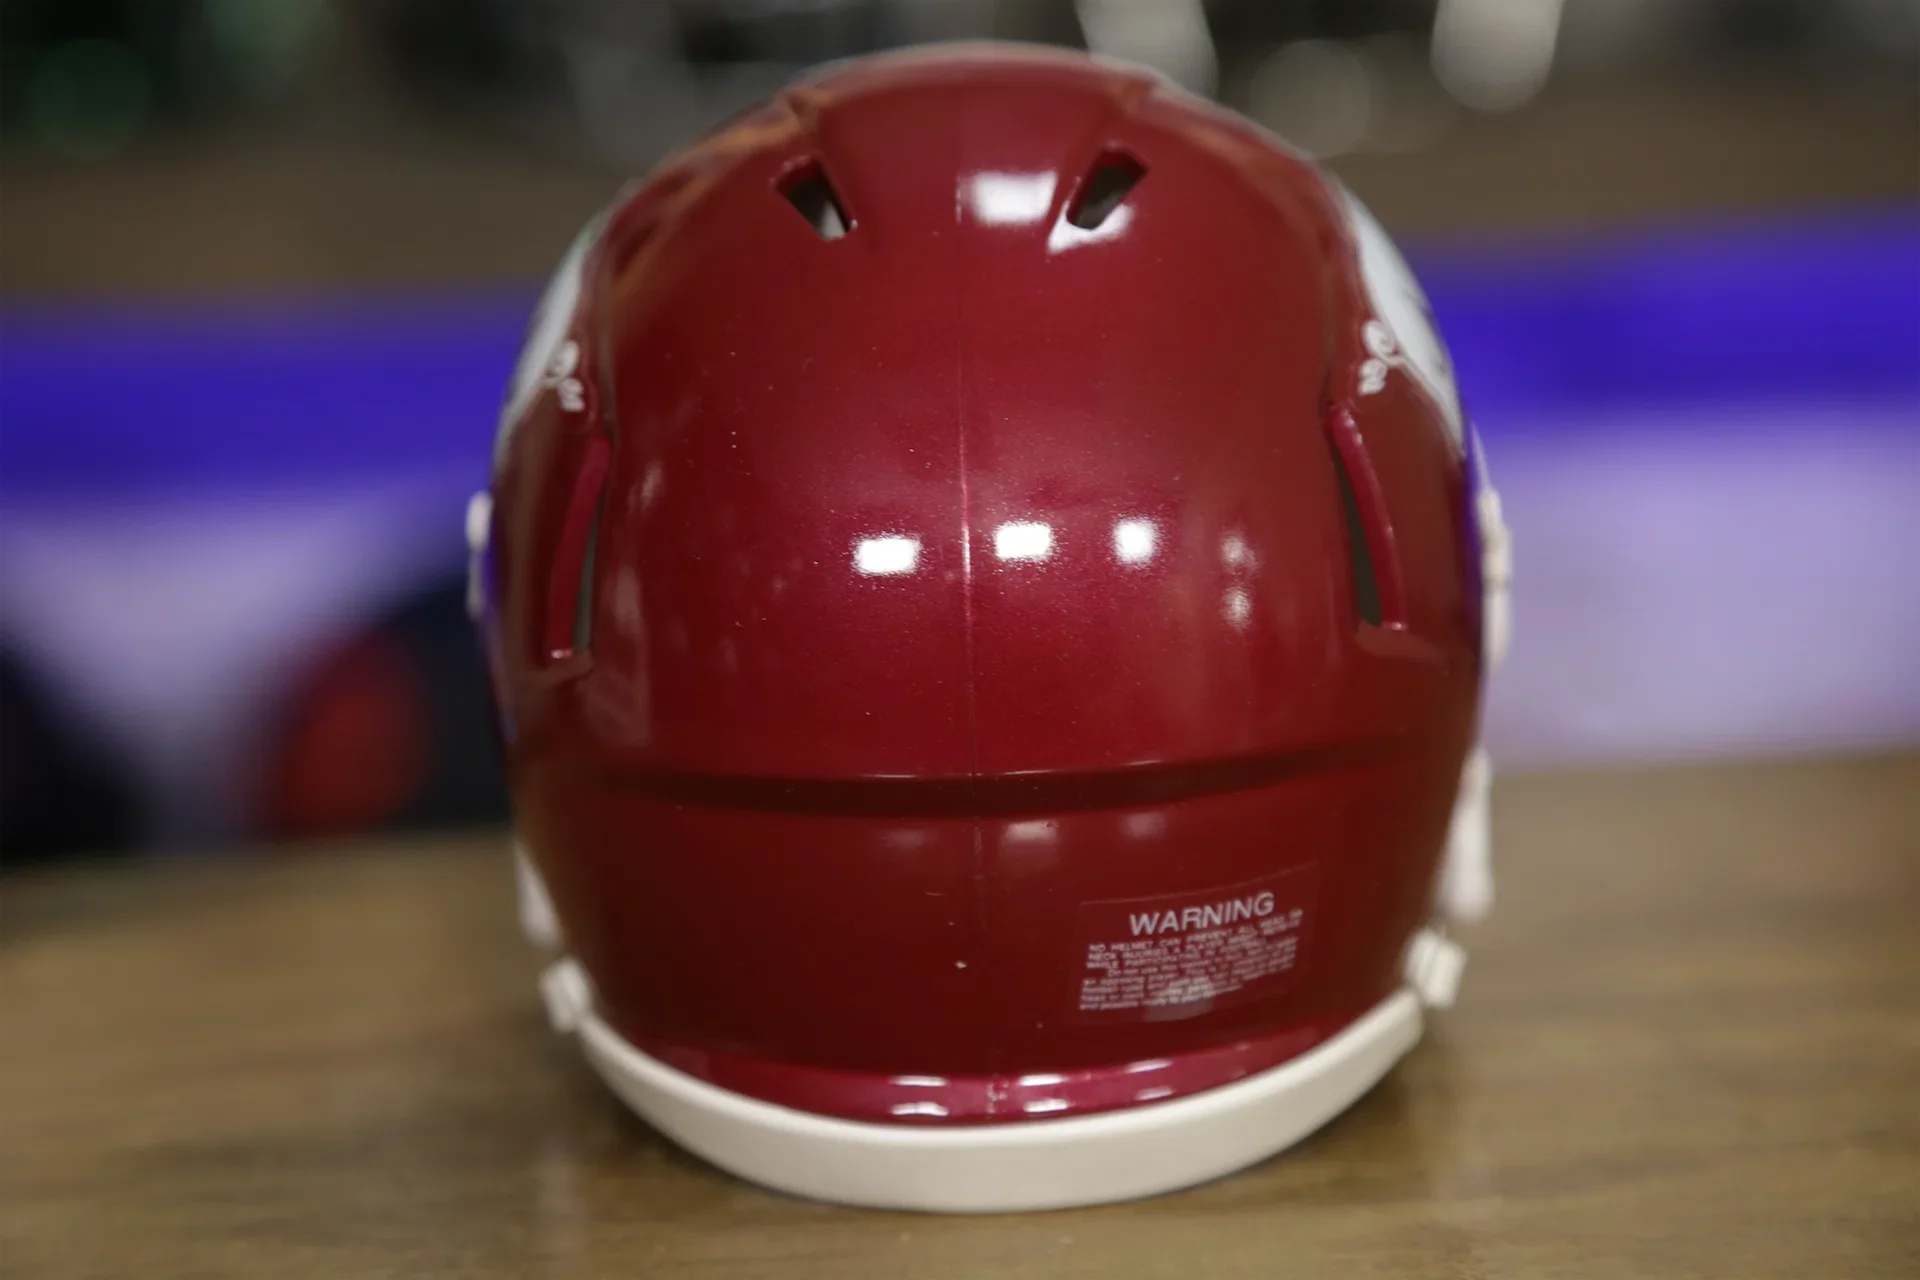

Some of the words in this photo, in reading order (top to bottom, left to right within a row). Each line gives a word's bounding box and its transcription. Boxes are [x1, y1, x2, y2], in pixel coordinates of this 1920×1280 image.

[1129, 891, 1275, 936] WARNING
[1088, 943, 1106, 952] NO
[1111, 940, 1154, 952] HELMET
